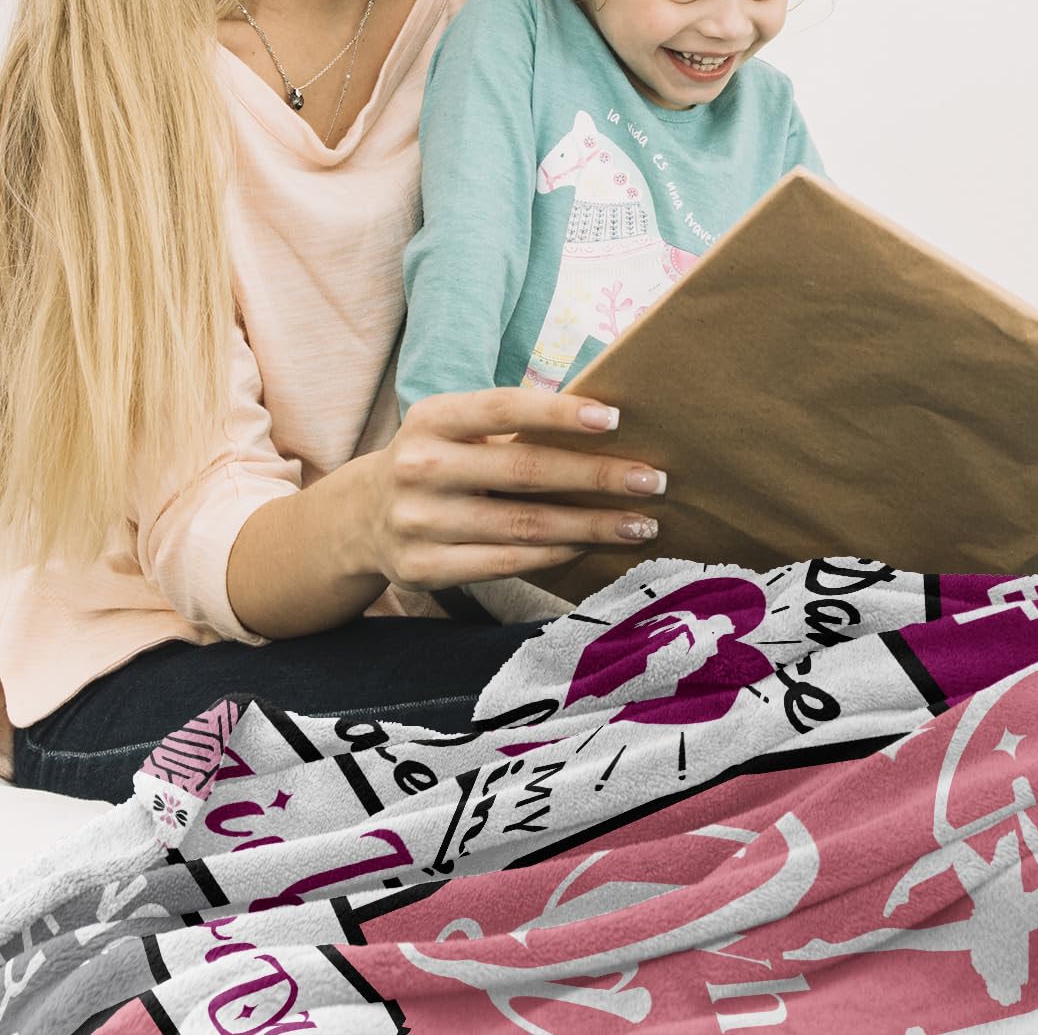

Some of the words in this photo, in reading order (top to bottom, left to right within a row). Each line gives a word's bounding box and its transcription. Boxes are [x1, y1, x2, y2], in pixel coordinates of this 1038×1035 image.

[606, 108, 621, 125] la
[627, 122, 649, 148] vida
[652, 153, 669, 171] es
